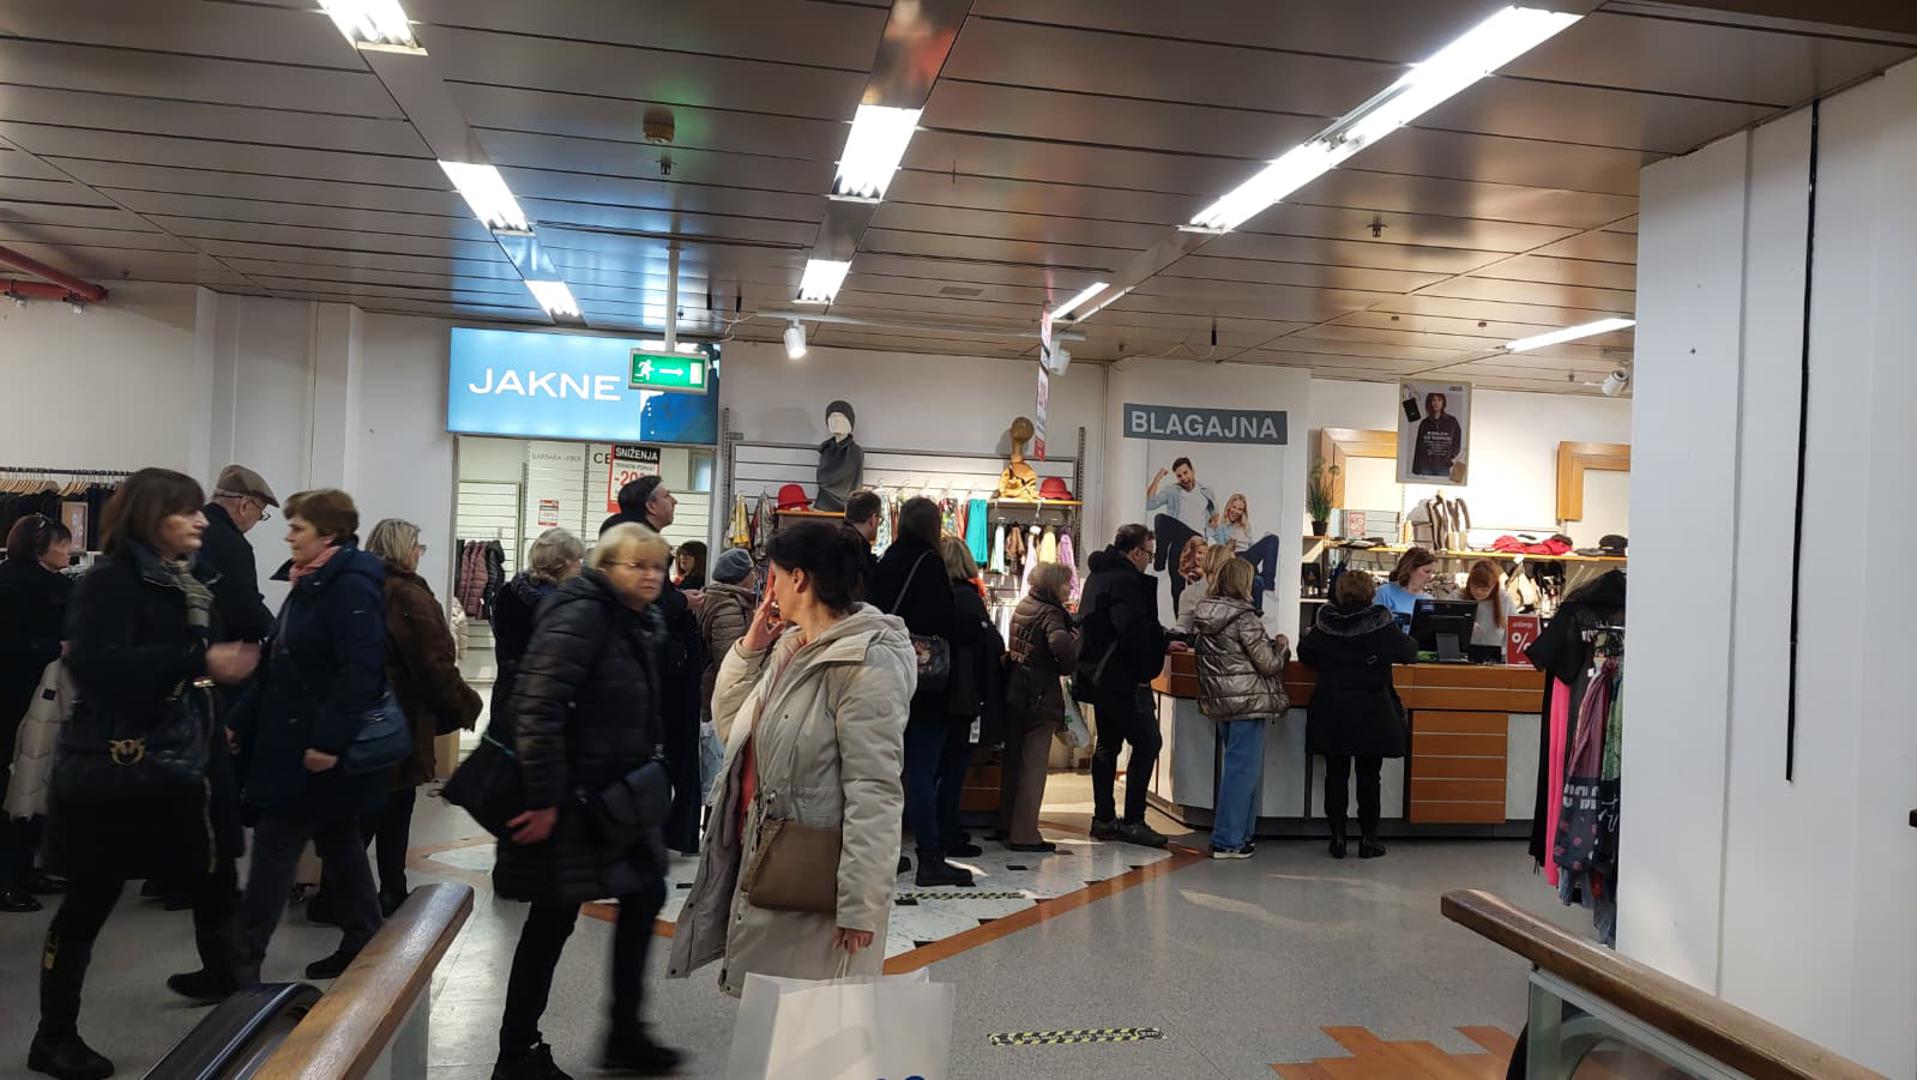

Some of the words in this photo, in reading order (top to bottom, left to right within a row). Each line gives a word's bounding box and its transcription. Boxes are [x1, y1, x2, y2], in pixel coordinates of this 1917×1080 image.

[469, 368, 622, 401] JAKNE
[1131, 410, 1278, 438] BLAGAJNA
[594, 453, 611, 465] CE
[615, 447, 658, 461] SNIŽENJA
[615, 470, 646, 487] -20
